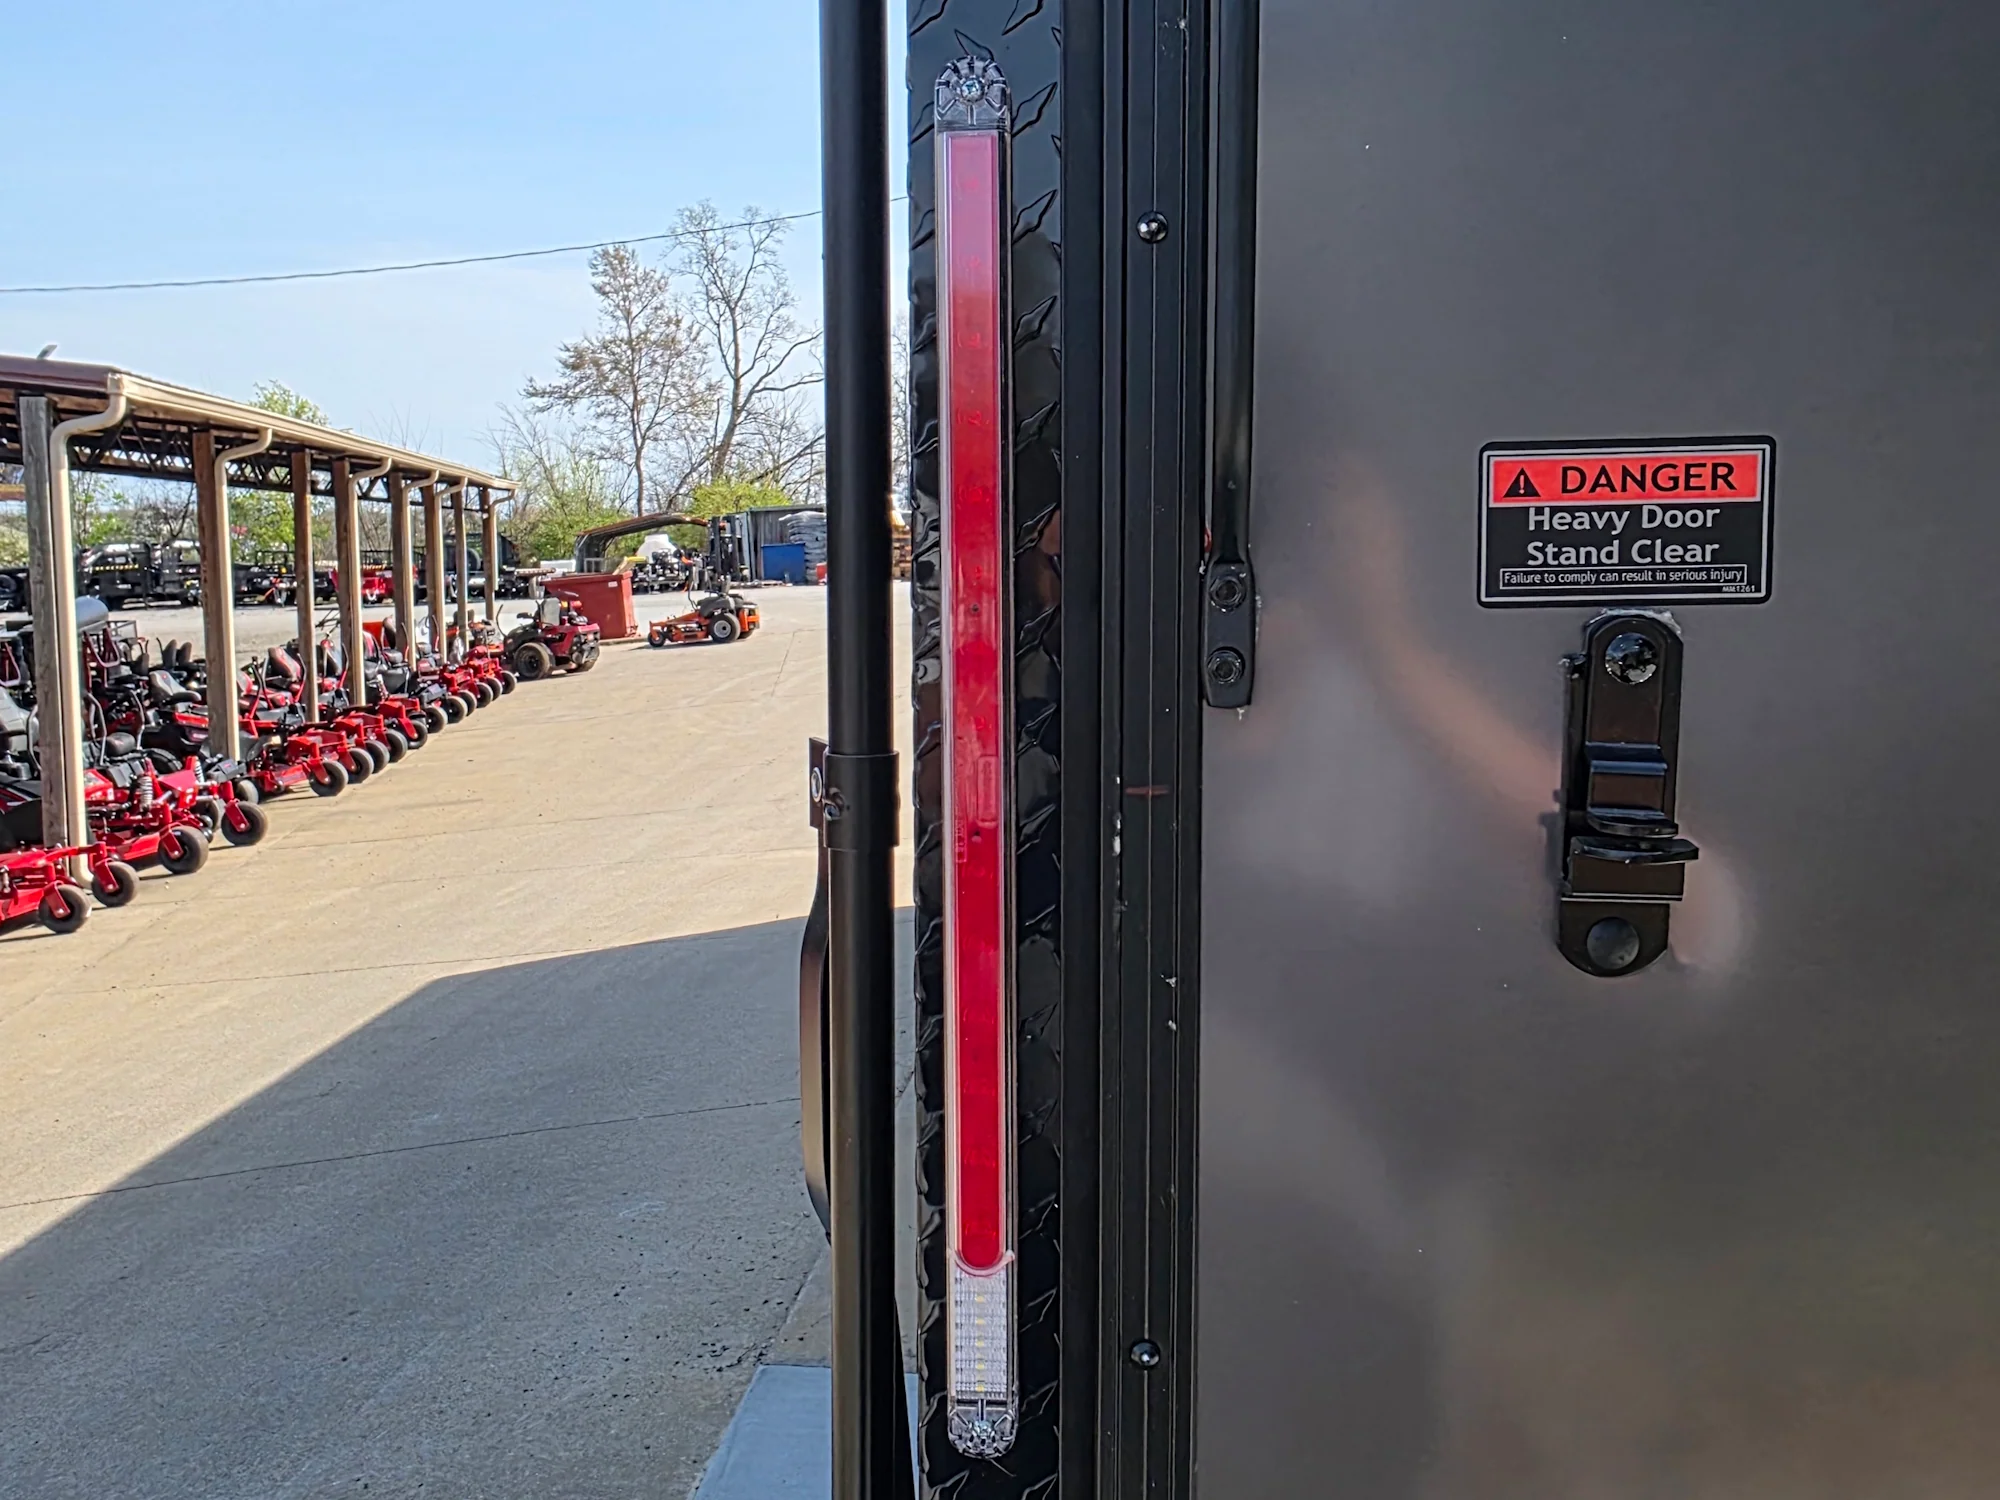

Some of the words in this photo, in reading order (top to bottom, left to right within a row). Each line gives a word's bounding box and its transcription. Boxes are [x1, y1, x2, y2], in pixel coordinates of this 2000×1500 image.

[1561, 463, 1737, 494] DANGER
[1528, 506, 1630, 535] Heavy
[1641, 504, 1720, 529] Door
[1526, 539, 1620, 566] Stand
[1630, 538, 1720, 564] Clear
[1504, 572, 1541, 583] Failure
[1544, 572, 1556, 583] to
[1558, 570, 1597, 585] comply
[1600, 572, 1619, 582] can
[1622, 569, 1652, 581] result
[1656, 569, 1666, 580] in
[1669, 568, 1707, 581] serious
[1710, 568, 1742, 582] injury
